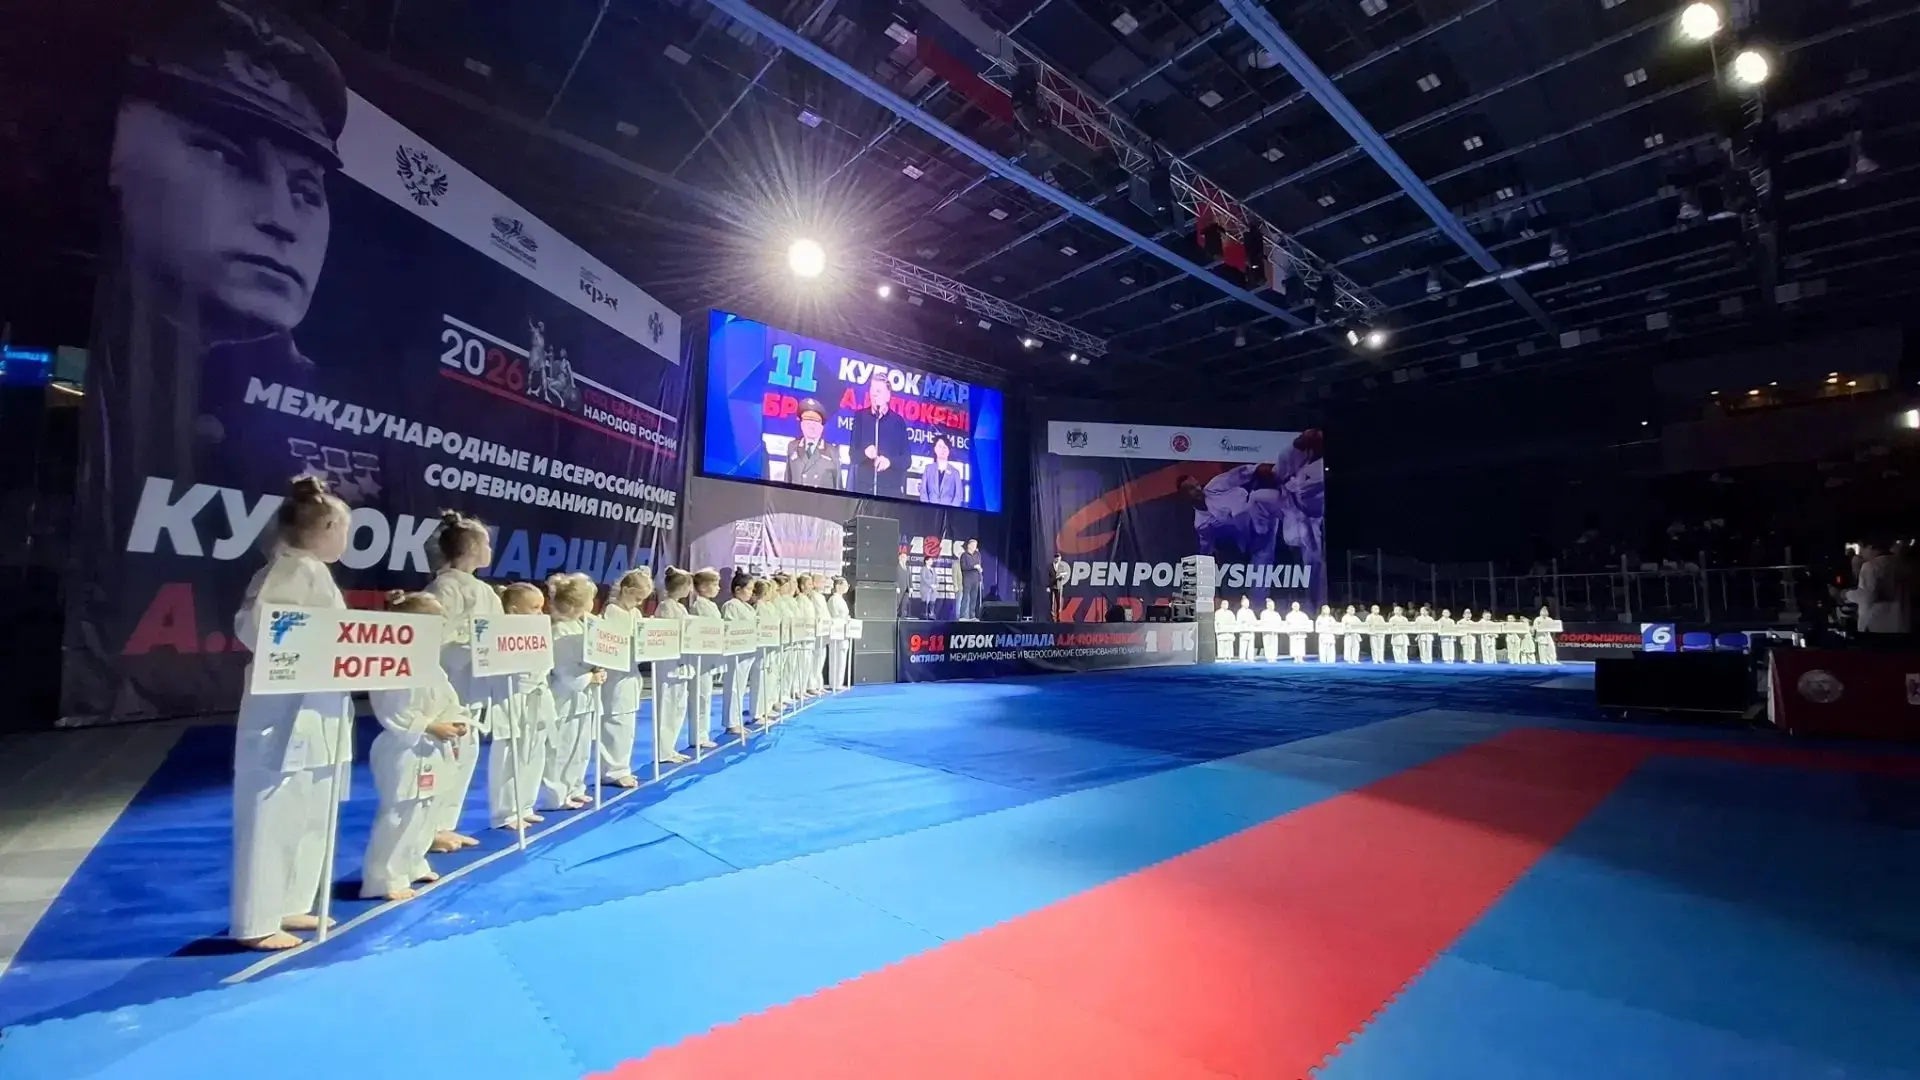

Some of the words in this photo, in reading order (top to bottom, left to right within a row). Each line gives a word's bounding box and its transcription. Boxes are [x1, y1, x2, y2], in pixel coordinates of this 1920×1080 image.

[441, 329, 524, 391] 2026
[768, 344, 817, 392] 11
[584, 404, 637, 435] НАРОДОВ
[639, 427, 677, 450] РОССИИ
[891, 397, 970, 431] ПОКРЫ
[243, 377, 530, 472] МЕЖДУНАРОДНЫЕ
[531, 453, 547, 476] И
[550, 458, 677, 506] ВСЕРОССИЙСКИЕ
[424, 464, 599, 517] СОРЕВНОВАНИЯ
[600, 498, 623, 520] ПО
[624, 504, 675, 530] КАРАТЭ
[127, 477, 443, 574] КУОК
[1132, 562, 1311, 588] POYSHKIN
[337, 621, 415, 645] ХМАО
[497, 636, 547, 652] МОСКВА
[950, 634, 994, 649] КУБОК
[995, 634, 1055, 647] МАРШАЛА
[1652, 627, 1671, 644] 6
[333, 656, 412, 678] ЮГРА
[910, 654, 945, 664] ОКТЯБРЯ
[950, 650, 1017, 662] МЕЖДУНАРОДНЫЕ
[1018, 650, 1023, 658] И
[1024, 648, 1074, 659] ВСЕРОССИЙСКИЕ
